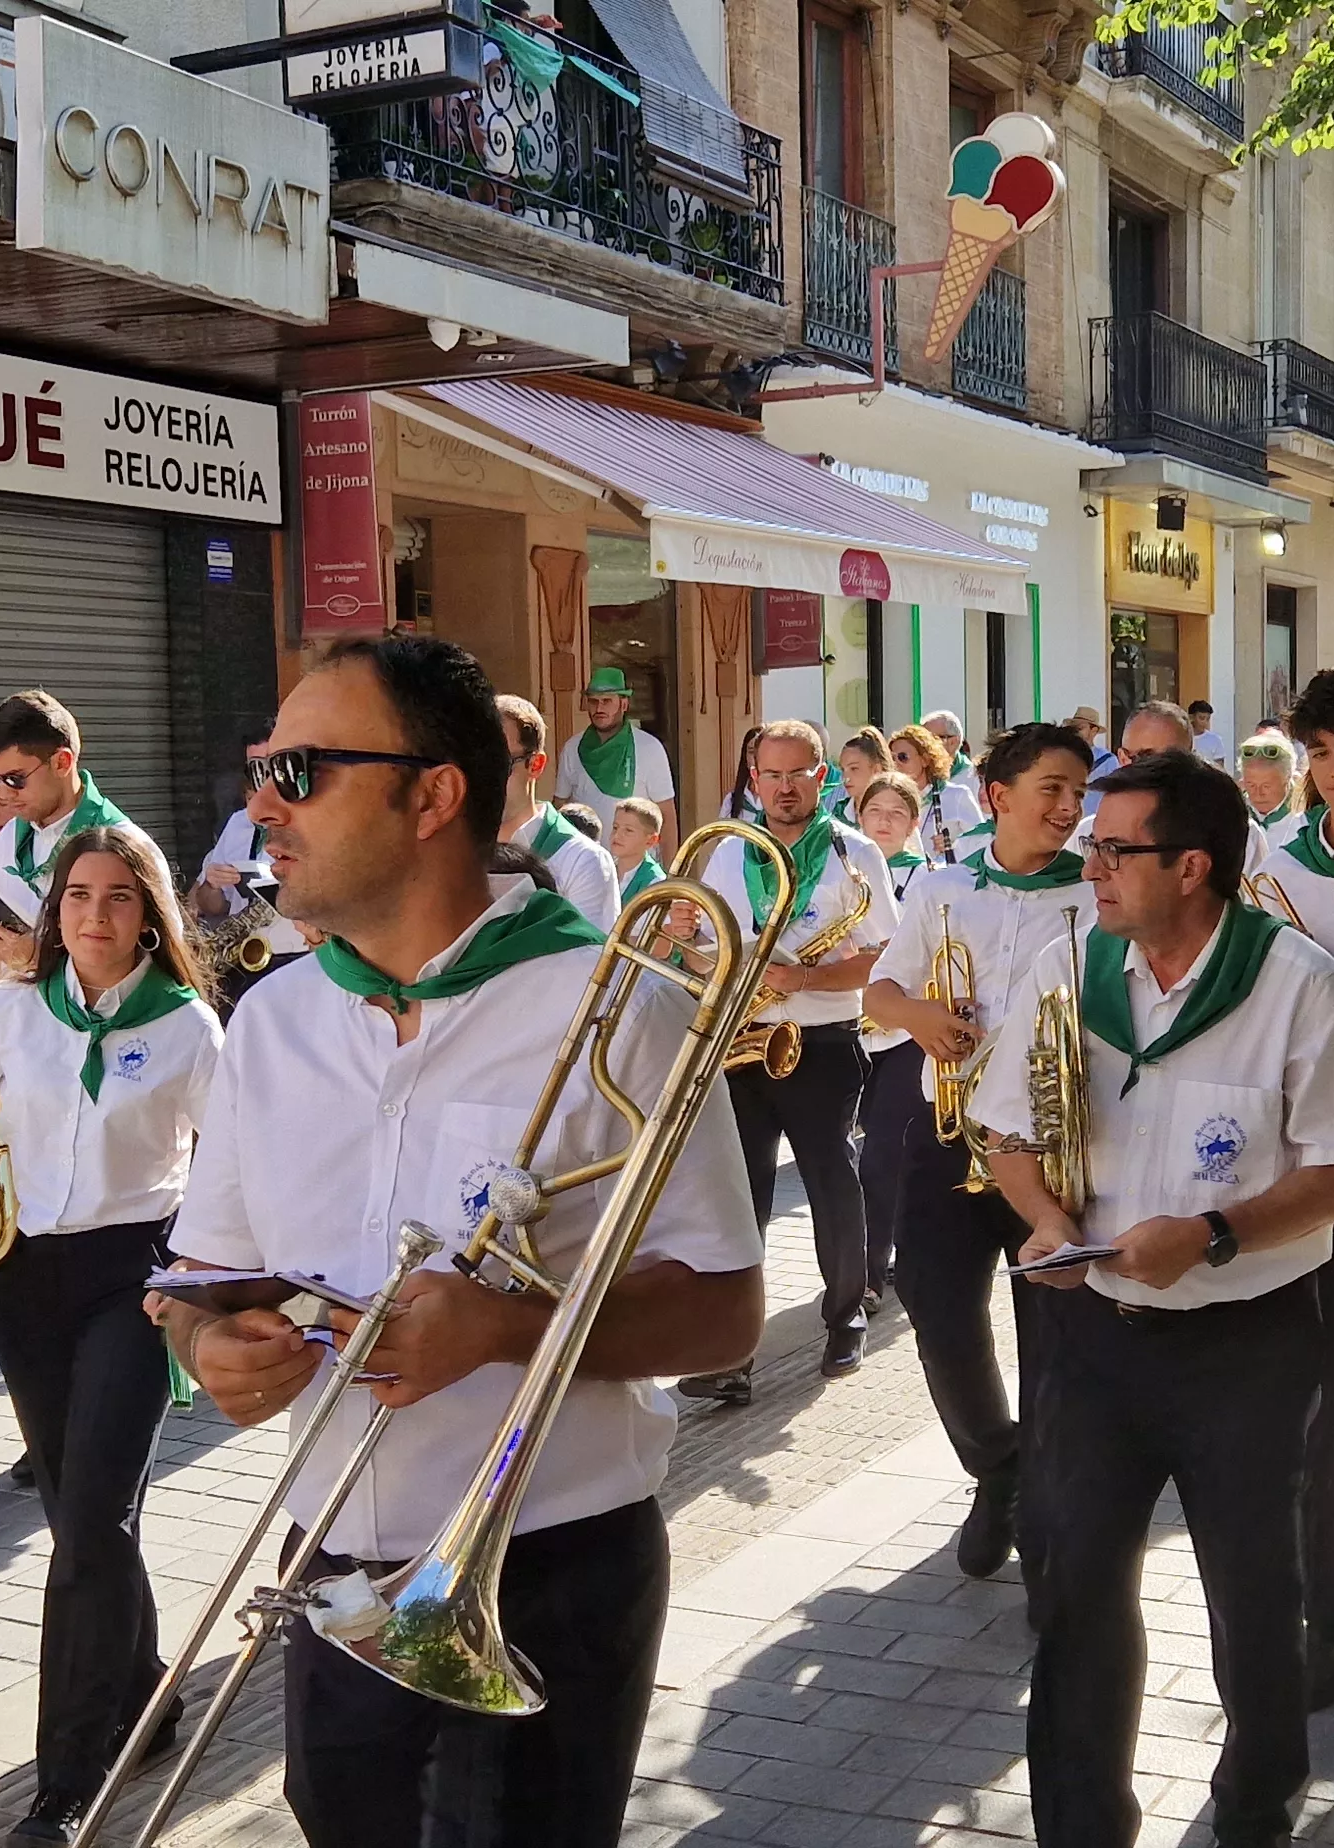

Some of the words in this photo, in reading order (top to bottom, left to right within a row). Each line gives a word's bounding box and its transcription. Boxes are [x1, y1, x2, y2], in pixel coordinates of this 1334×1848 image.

[323, 36, 408, 68] JOYERIA
[312, 57, 421, 94] RELOJERIA
[54, 105, 324, 251] CONRAT
[104, 396, 235, 450] JOYERÍA
[309, 404, 357, 423] Turrón
[304, 441, 368, 457] Artesano
[104, 449, 268, 505] RELOJERÍA
[305, 476, 323, 491] de
[325, 473, 369, 493] Jijona
[693, 535, 763, 577] Degustación
[334, 575, 360, 585] Origen
[1191, 1171, 1240, 1184] HUESCA
